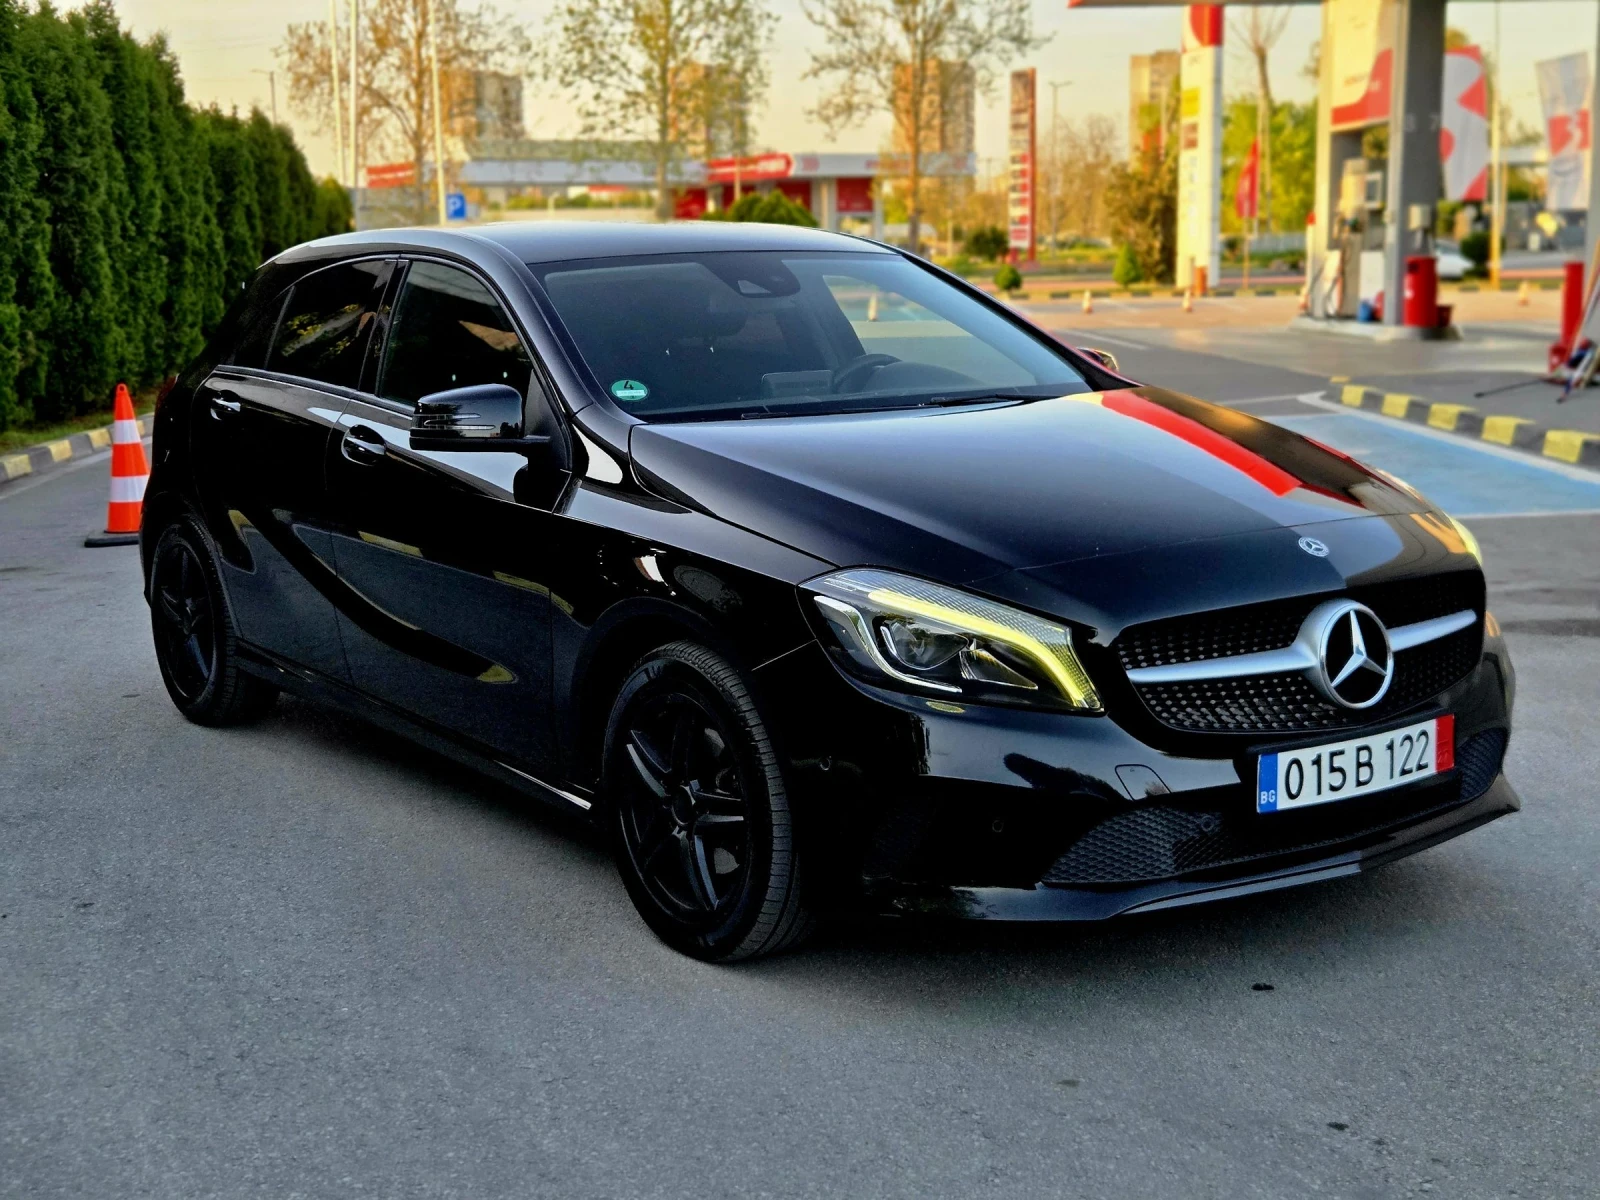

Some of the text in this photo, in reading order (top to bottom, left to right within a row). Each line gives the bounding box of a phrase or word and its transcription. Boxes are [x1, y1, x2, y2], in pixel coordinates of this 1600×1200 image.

[448, 197, 462, 217] P
[623, 380, 634, 390] 4
[1385, 729, 1429, 780] 122
[1260, 789, 1276, 804] BG
